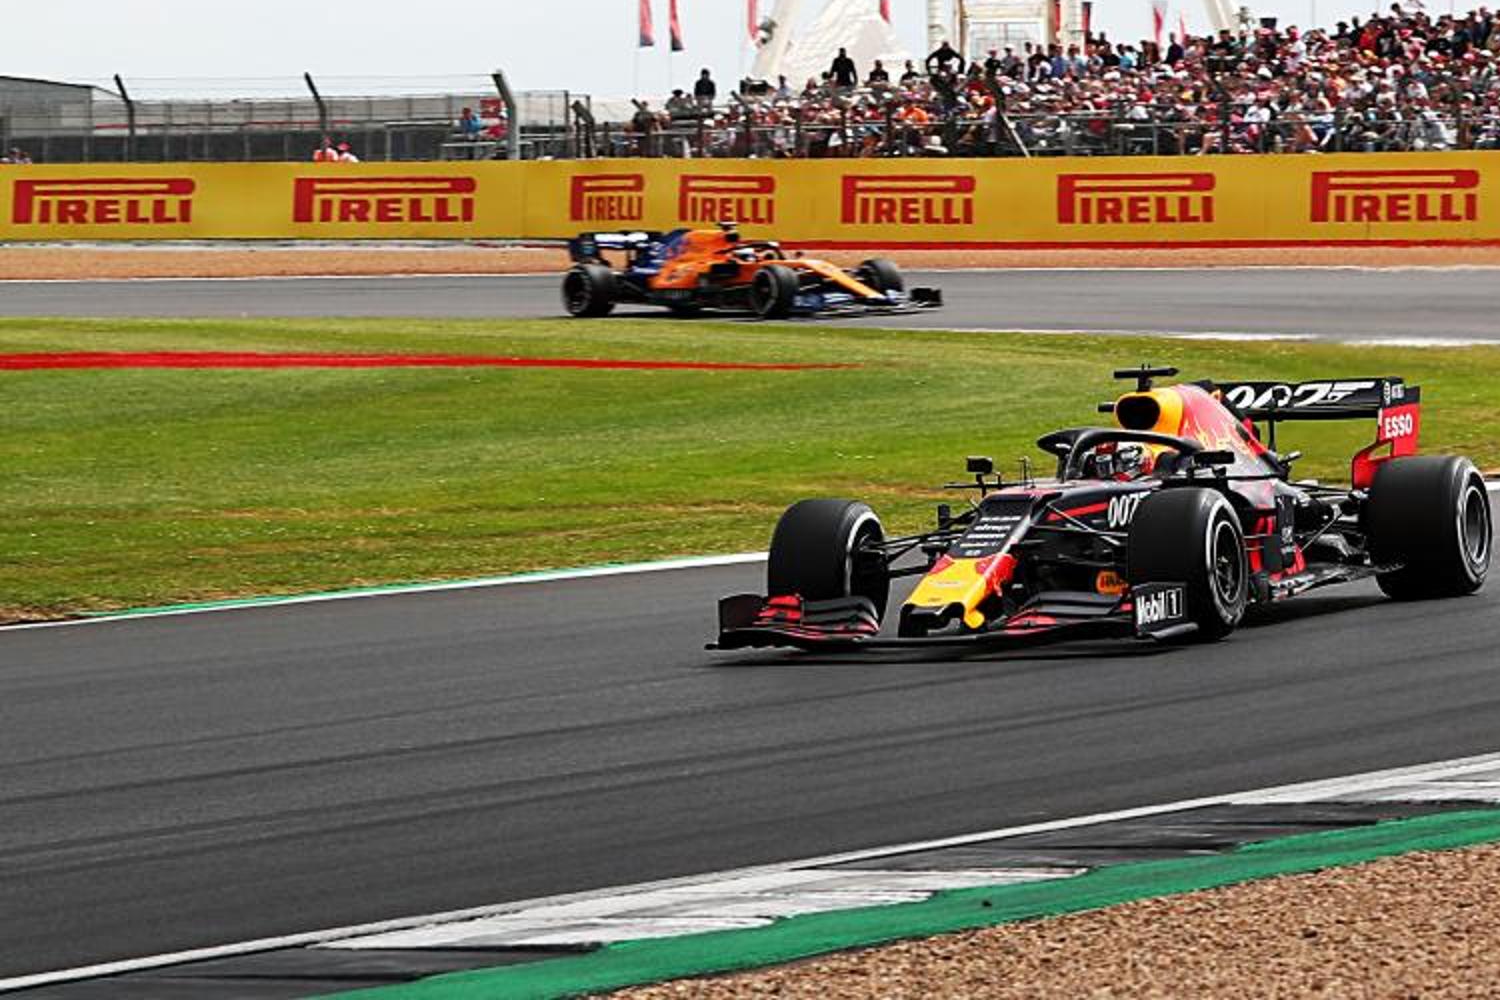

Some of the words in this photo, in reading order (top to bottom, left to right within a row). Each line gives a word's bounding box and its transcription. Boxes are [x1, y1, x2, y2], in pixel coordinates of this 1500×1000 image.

[12, 177, 196, 224] PIRELLI
[293, 176, 476, 222] PIRELLI
[570, 174, 644, 221] PIRELLI
[679, 175, 775, 224] PIRELLI
[840, 174, 975, 224] PIRELLI
[1057, 173, 1216, 224] PIRELLI
[1310, 169, 1479, 222] PIRELLI
[1384, 413, 1413, 438] ESSO
[1107, 491, 1150, 528] 007
[1135, 590, 1166, 625] Mobil
